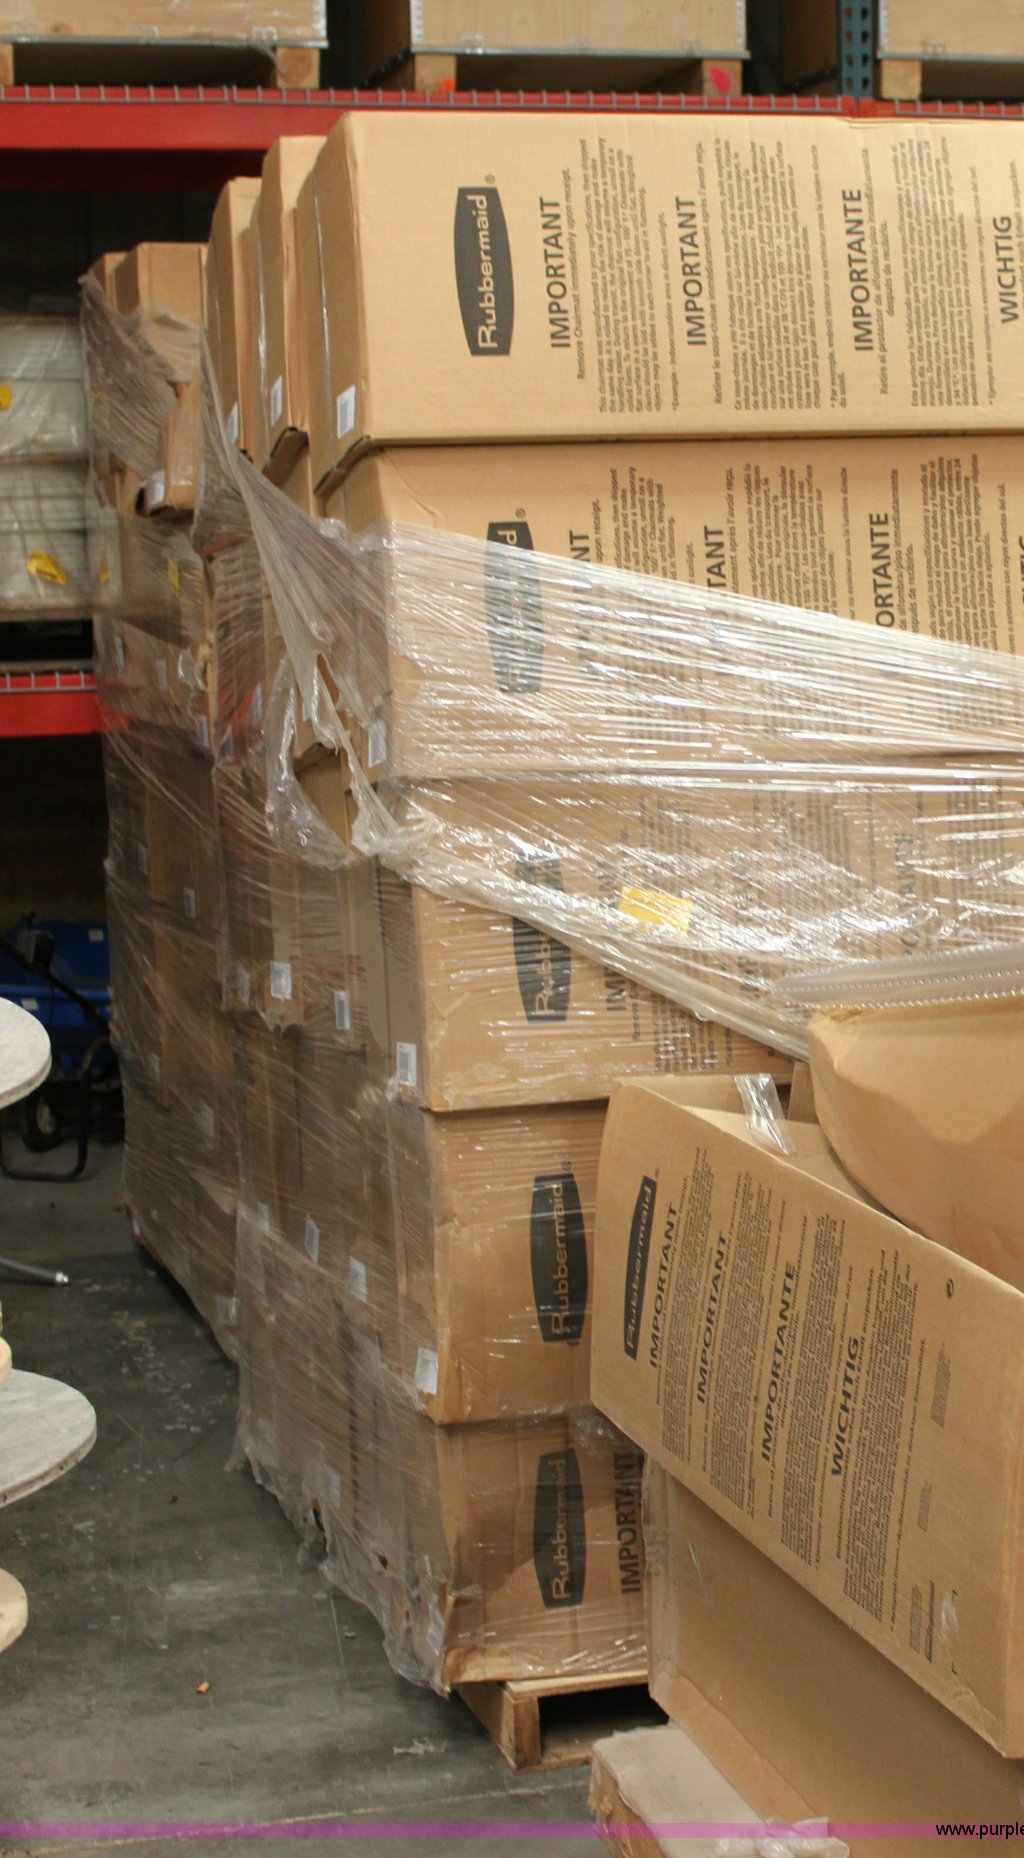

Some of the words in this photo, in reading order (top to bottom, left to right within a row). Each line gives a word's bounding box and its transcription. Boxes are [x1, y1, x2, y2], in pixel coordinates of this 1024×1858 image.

[466, 194, 498, 347] Rubbermaid
[539, 196, 571, 348] IMPORTANT
[675, 196, 706, 346] IMPORTANT
[841, 188, 874, 351] IMPORTANTE
[991, 215, 1019, 323] WICHTIG
[867, 512, 895, 628] ORTANTE
[908, 601, 920, 632] espués
[551, 1181, 571, 1335] Rubbermaid
[627, 1185, 653, 1350] Rubbermaid
[649, 1202, 679, 1368] IMPORTANT
[696, 1230, 730, 1404] IMPORTANT
[761, 1261, 797, 1462] IMPORTANTE
[831, 1336, 861, 1477] WICHTIG
[549, 1459, 572, 1601] Rubbermaid
[614, 1451, 641, 1594] IMPORTANT
